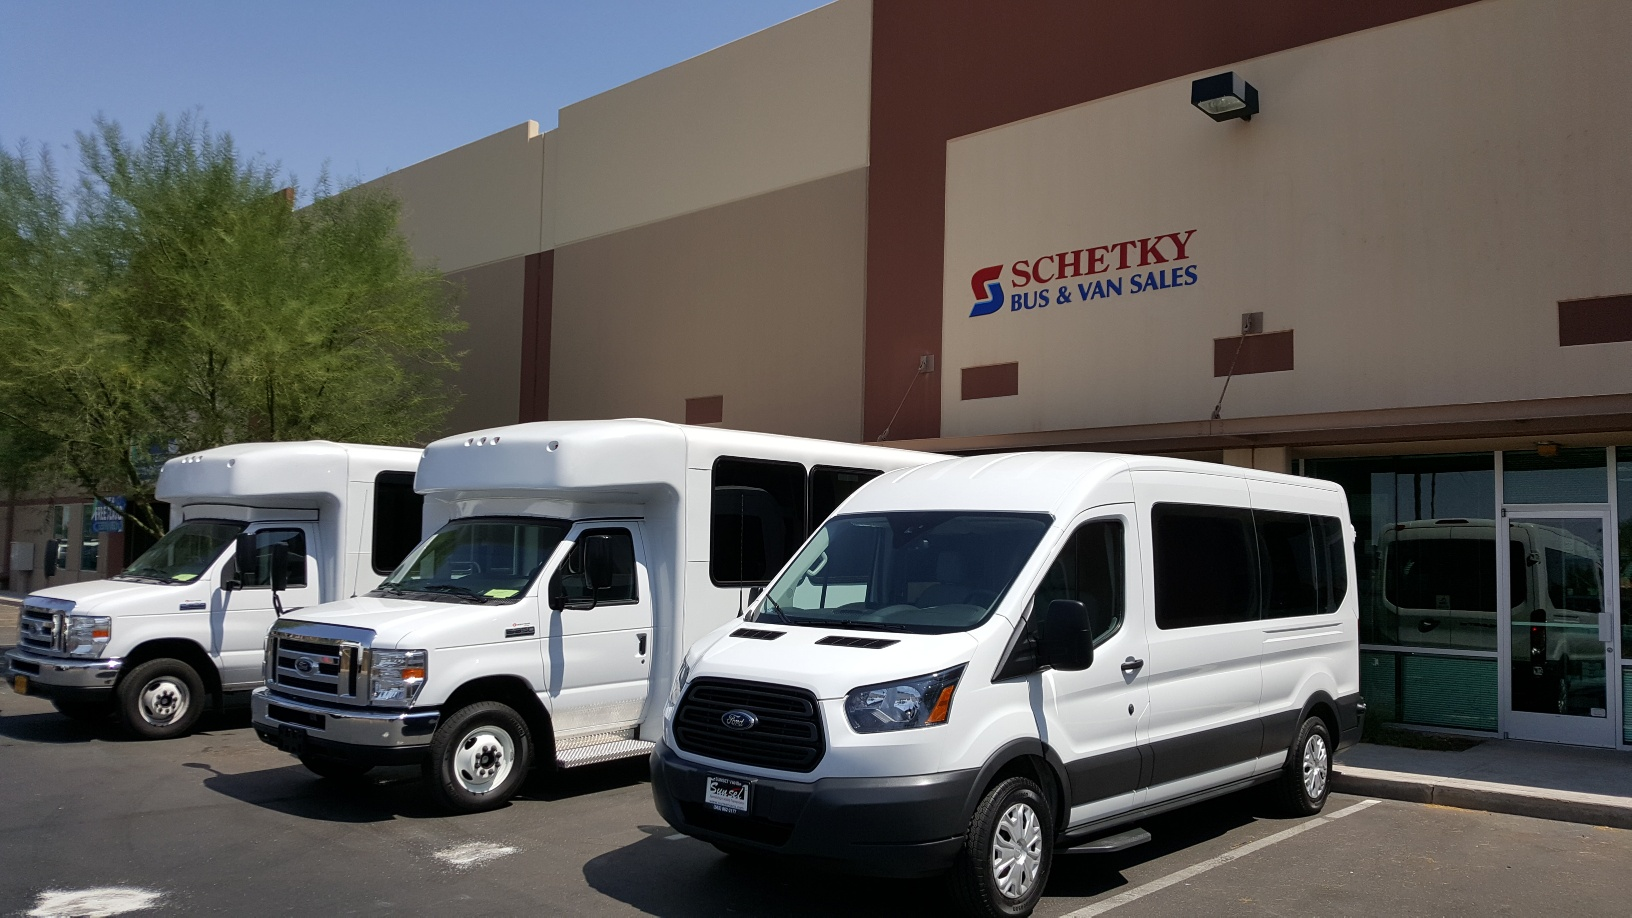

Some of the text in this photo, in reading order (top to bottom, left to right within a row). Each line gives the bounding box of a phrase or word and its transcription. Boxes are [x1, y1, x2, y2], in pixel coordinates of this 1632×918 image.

[1011, 229, 1198, 288] SCHETKY
[1010, 264, 1198, 312] BUS & VAN SALES
[726, 713, 745, 727] Ford
